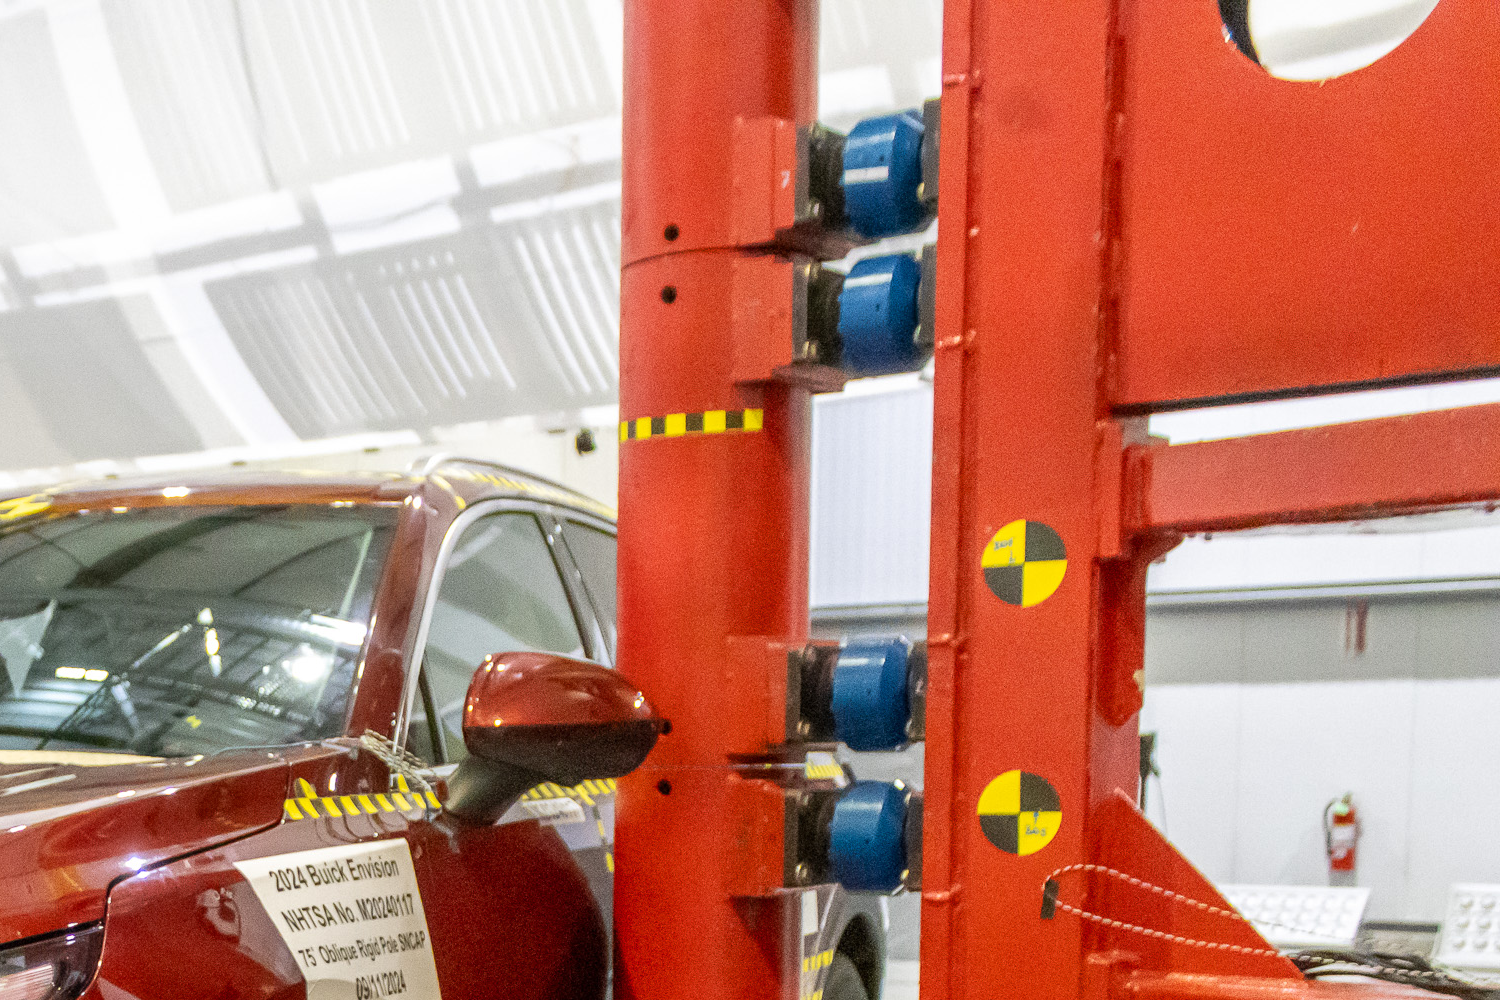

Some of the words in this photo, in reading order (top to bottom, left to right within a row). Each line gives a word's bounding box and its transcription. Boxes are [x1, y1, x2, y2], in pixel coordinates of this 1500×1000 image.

[269, 868, 308, 893] 2024
[306, 862, 350, 887] Buick
[346, 856, 399, 882] Envision
[281, 904, 338, 933] NHTSA
[334, 902, 357, 925] No.
[356, 893, 414, 921] M20240117
[318, 941, 358, 965] Oblique
[356, 938, 381, 962] Rigid
[380, 935, 398, 957] Pole
[398, 930, 426, 951] SNCAP
[355, 969, 407, 1000] 09/11/2024
